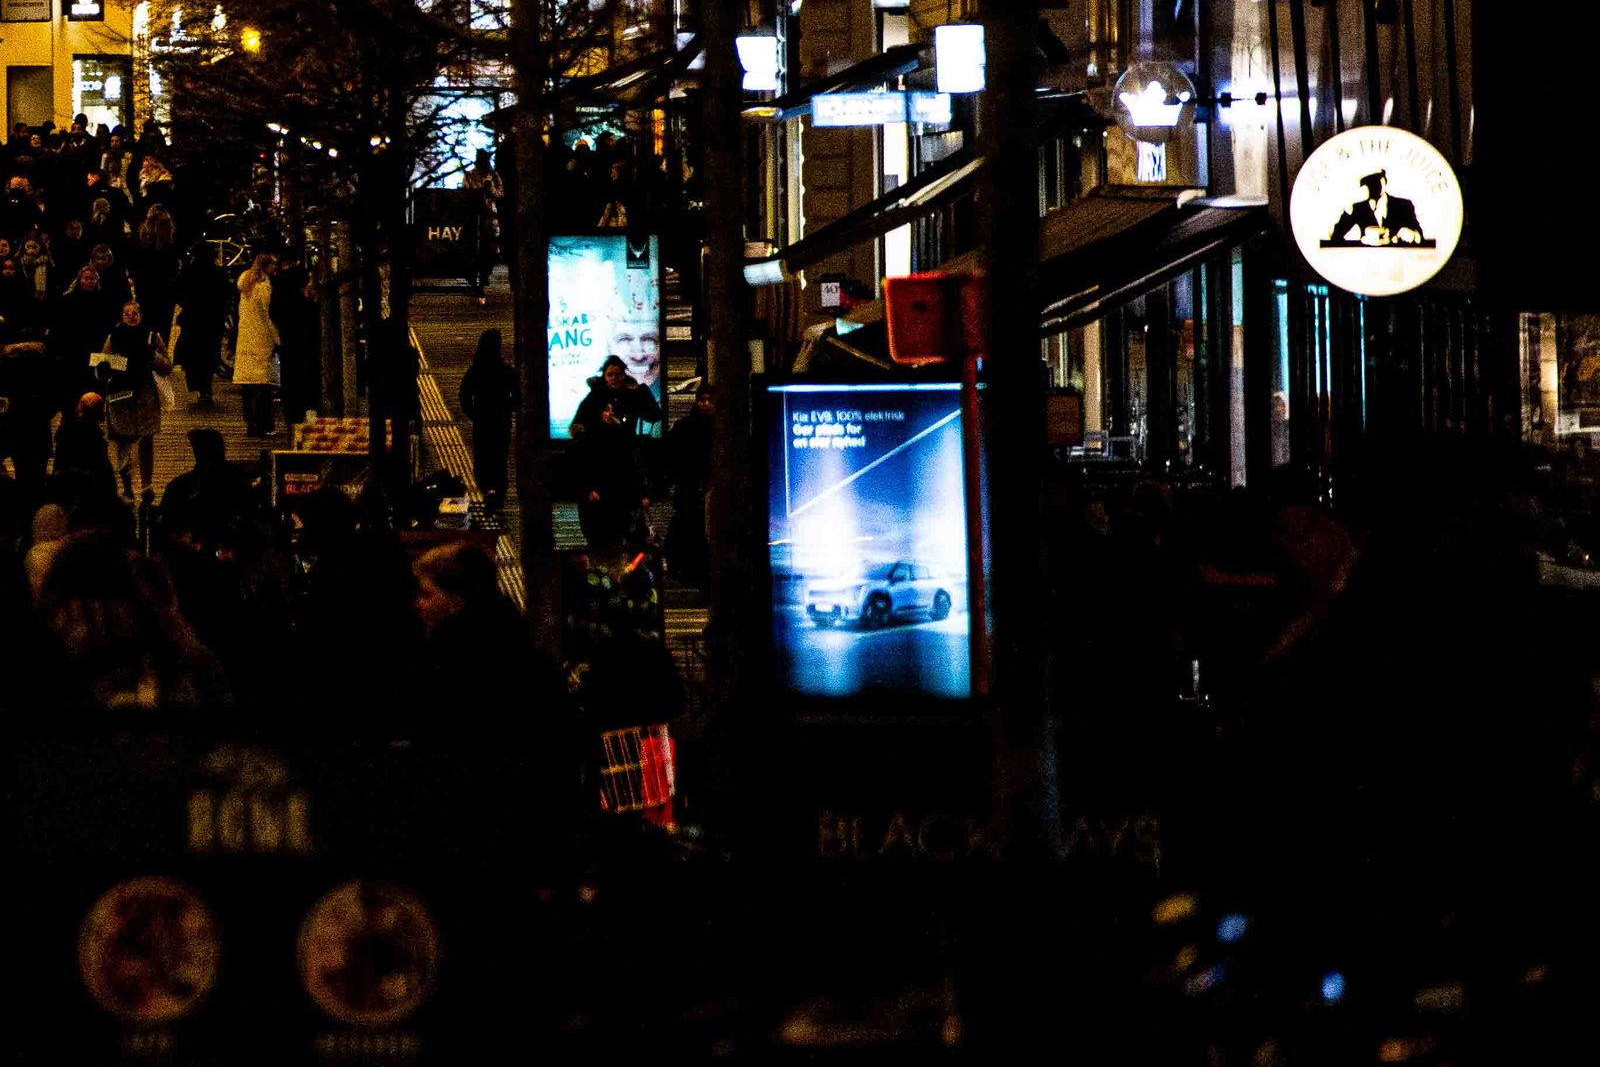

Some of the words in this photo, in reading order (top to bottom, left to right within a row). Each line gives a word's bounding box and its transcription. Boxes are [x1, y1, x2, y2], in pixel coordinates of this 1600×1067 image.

[428, 226, 463, 241] HAY
[792, 411, 808, 423] Kia
[836, 410, 862, 422] 100%
[864, 410, 904, 422] elektrisk
